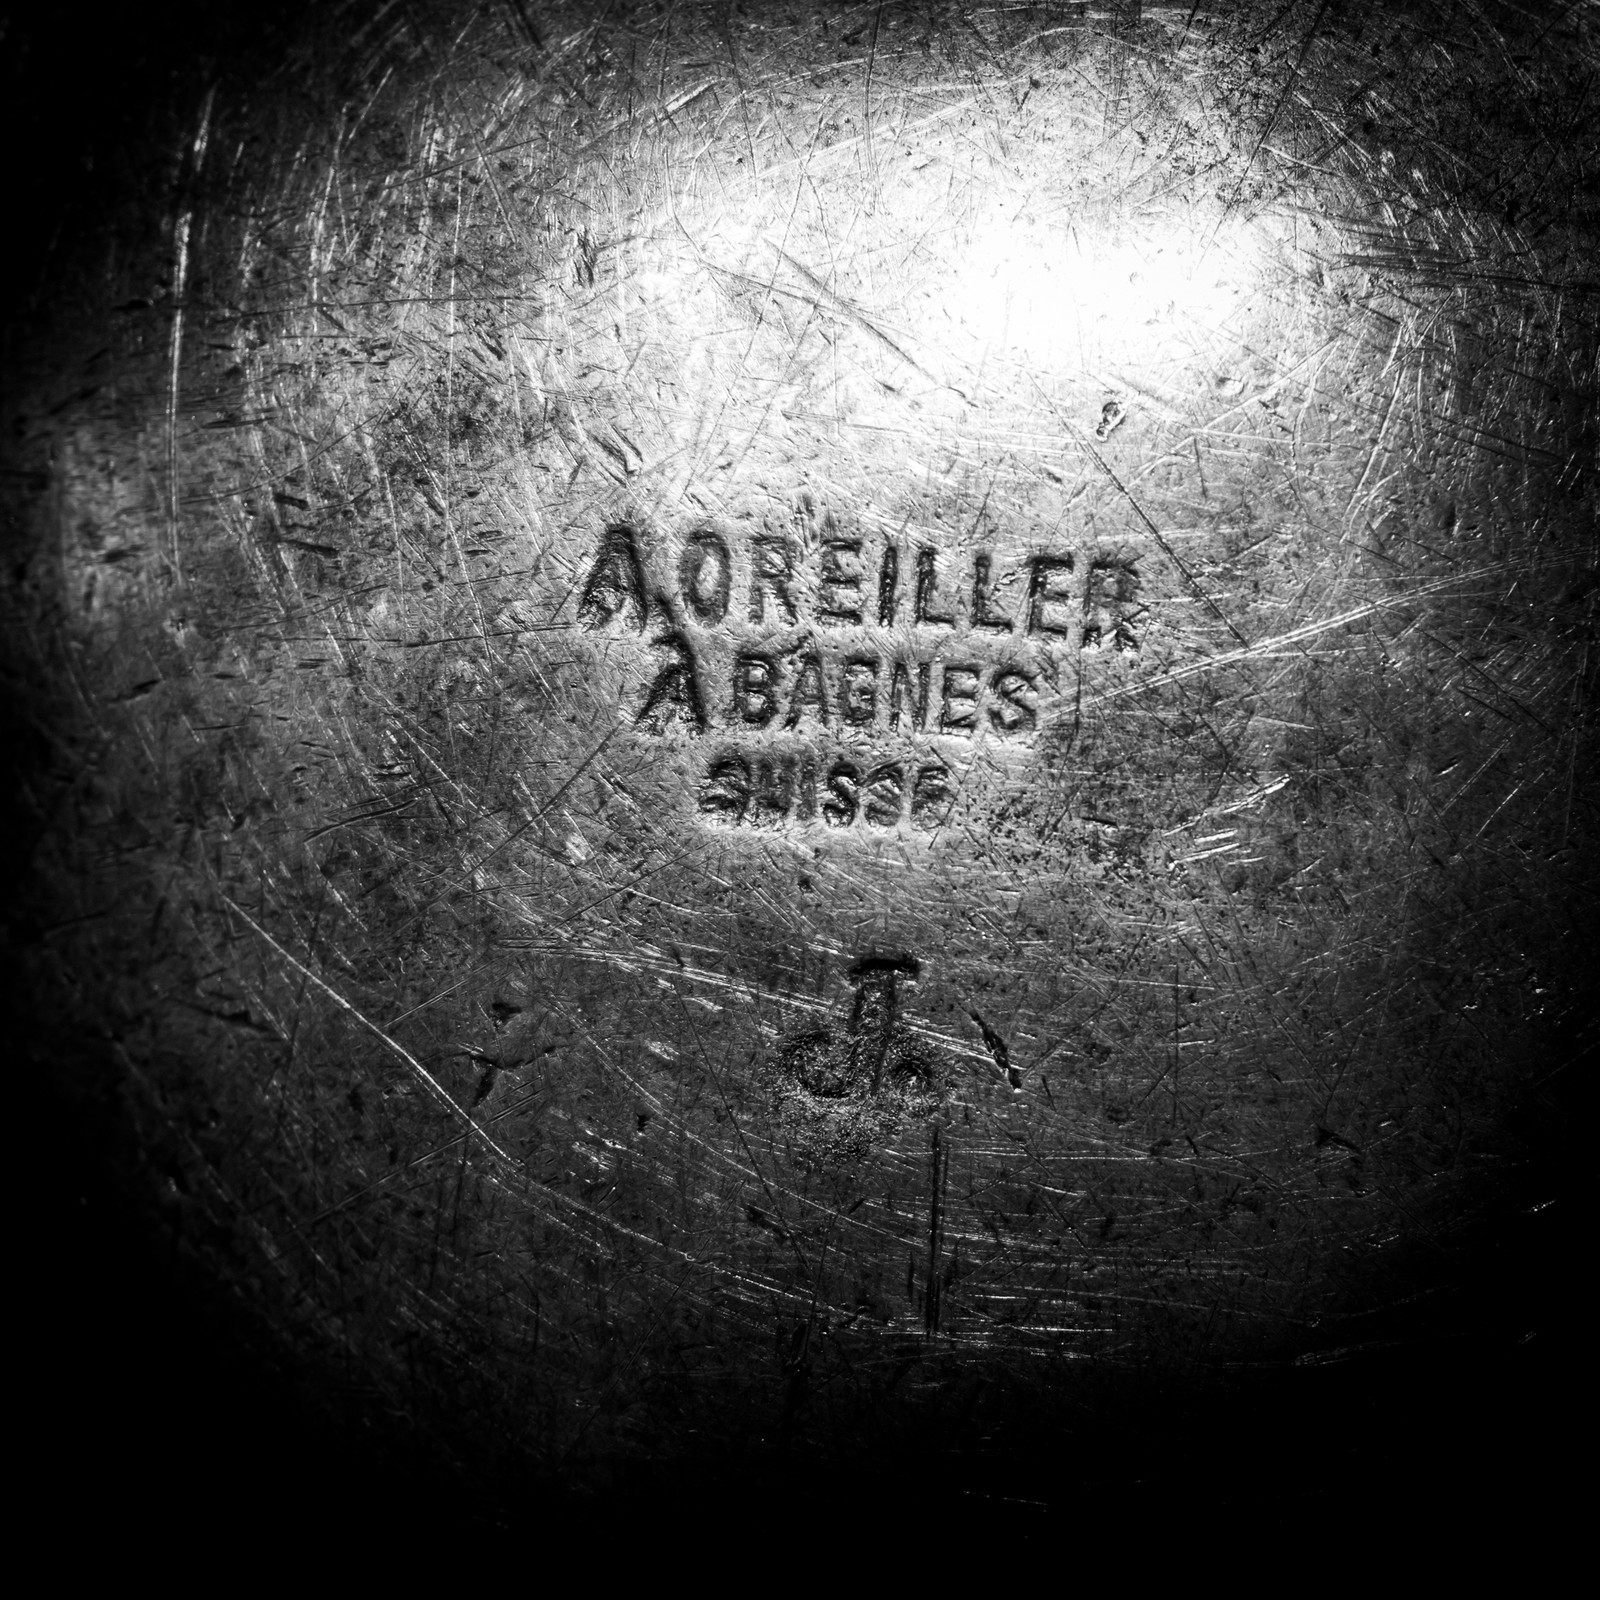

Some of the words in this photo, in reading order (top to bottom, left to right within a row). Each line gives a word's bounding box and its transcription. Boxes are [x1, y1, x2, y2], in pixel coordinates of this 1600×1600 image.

[677, 525, 1150, 650] OREILLER
[733, 648, 1040, 735] BAGNES
[698, 750, 952, 828] SUISSE
